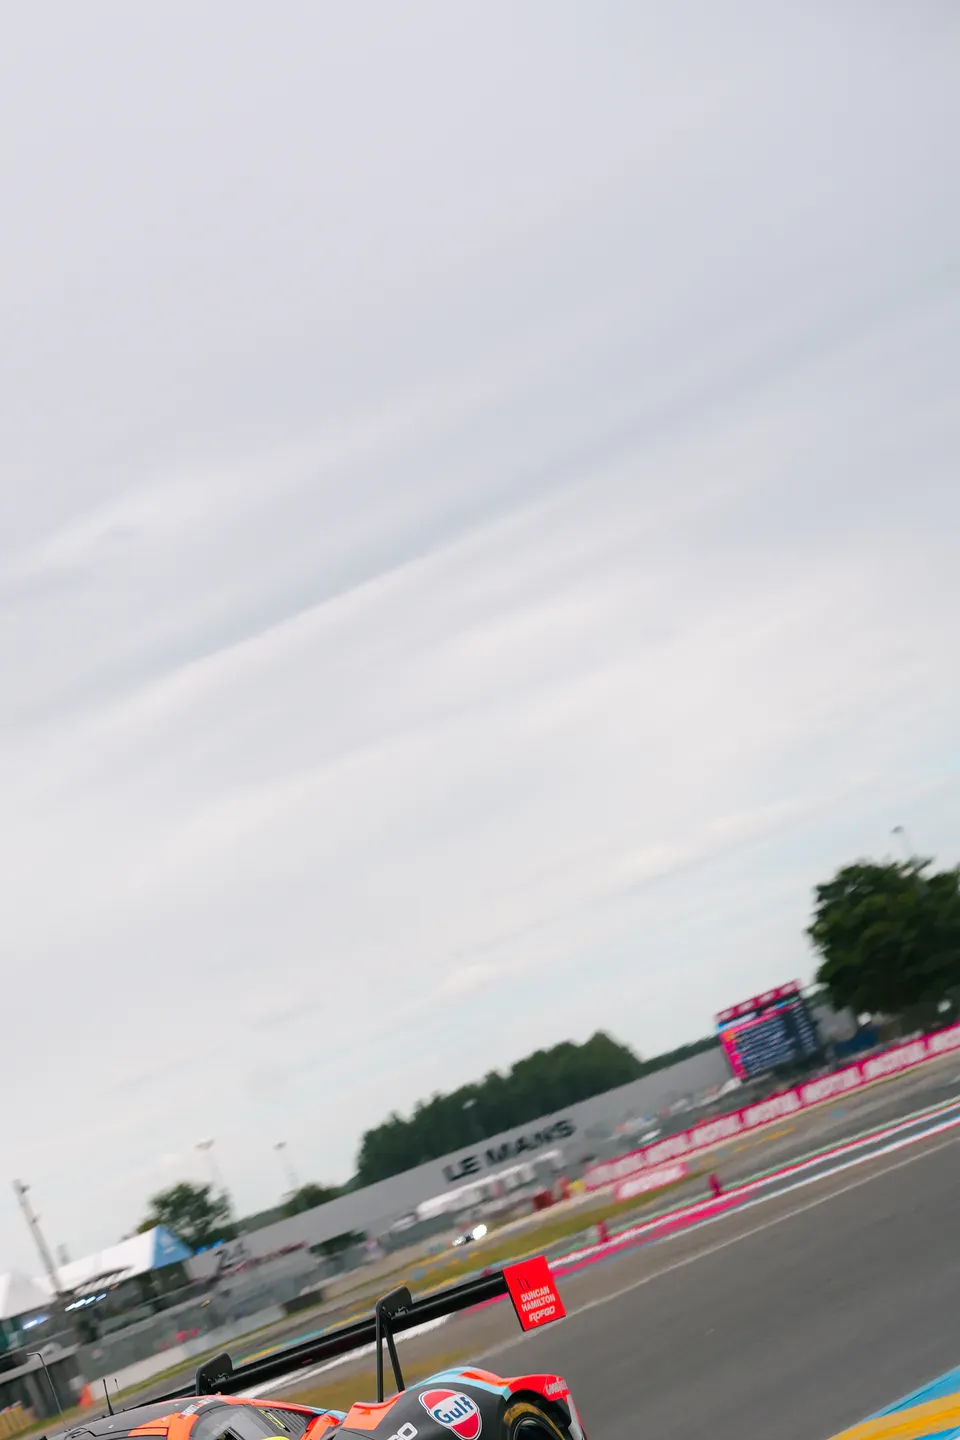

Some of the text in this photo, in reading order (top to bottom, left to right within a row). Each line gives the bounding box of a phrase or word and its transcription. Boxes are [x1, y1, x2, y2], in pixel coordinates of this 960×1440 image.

[442, 1117, 577, 1183] LE MANS
[521, 1285, 550, 1303] DUNCAN
[521, 1293, 556, 1312] HAMILTON
[528, 1305, 556, 1323] ROFGO
[433, 1396, 475, 1424] Gulf
